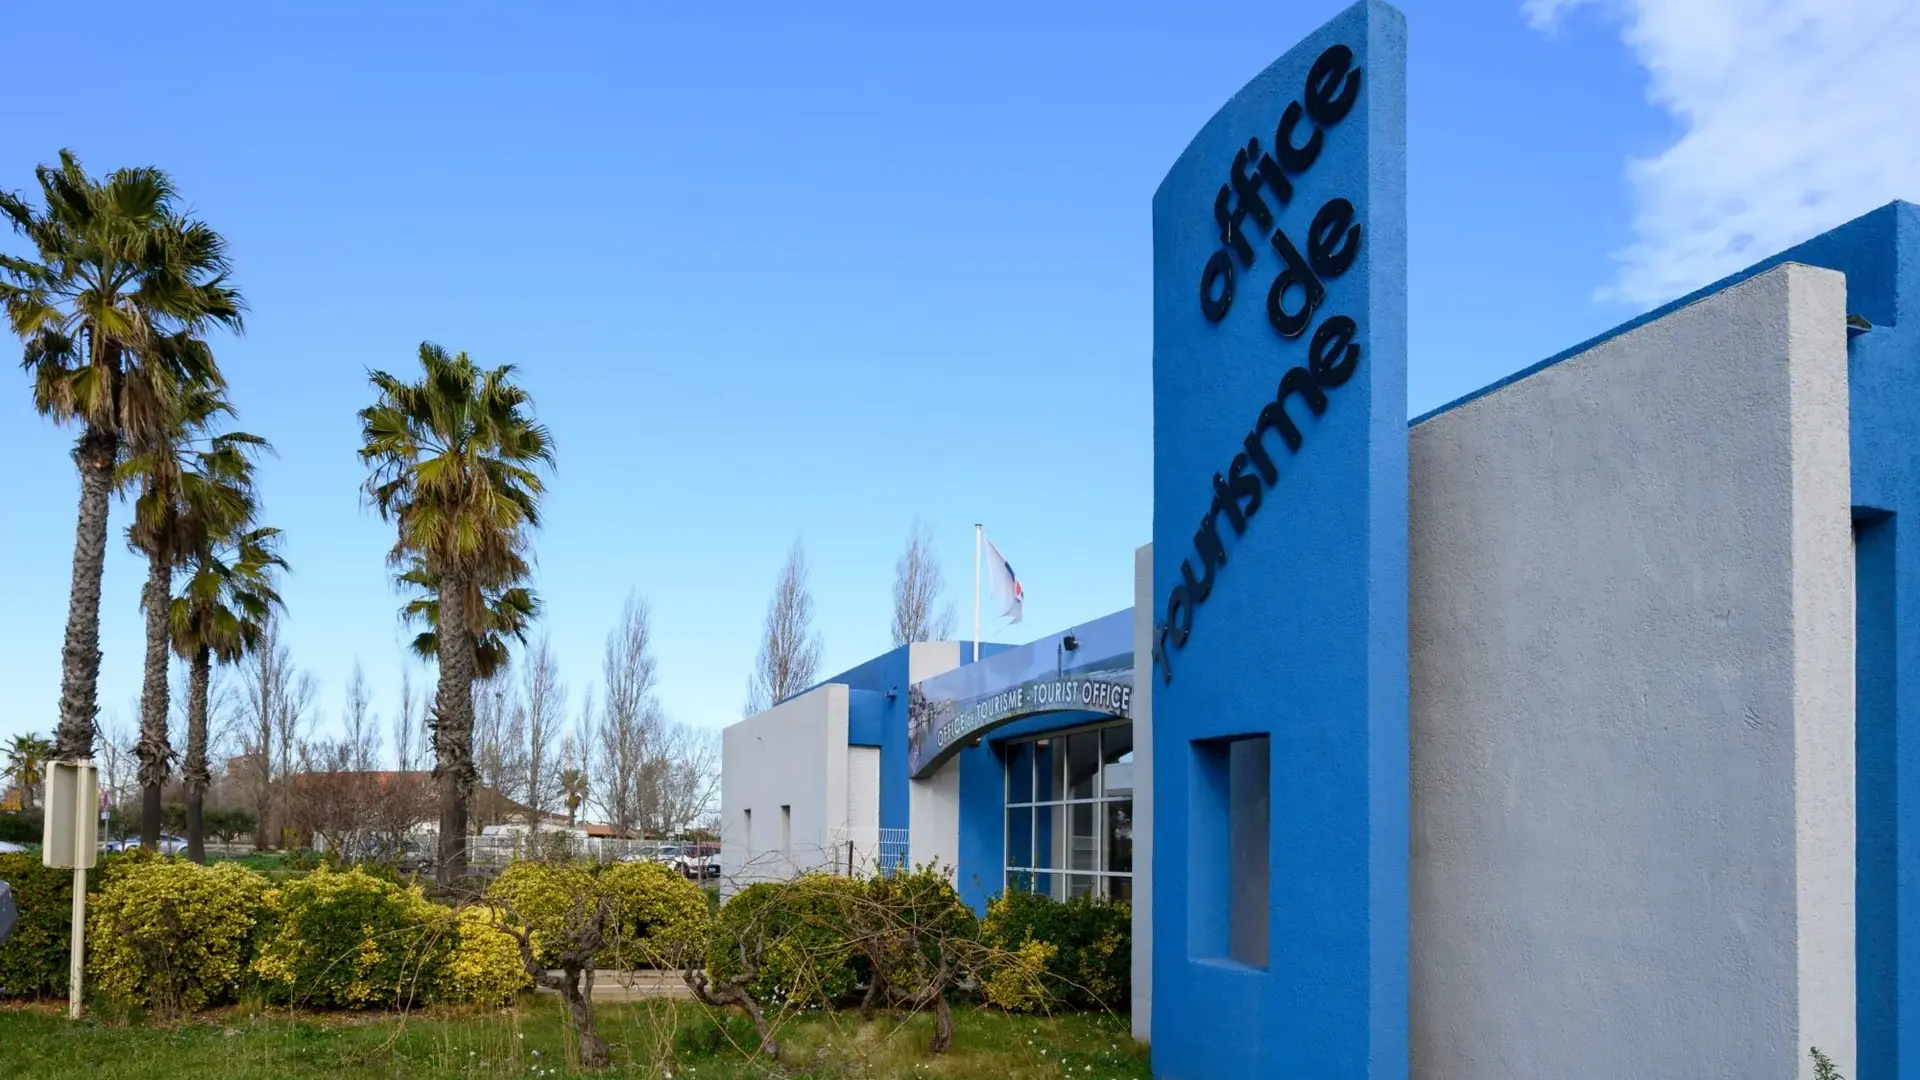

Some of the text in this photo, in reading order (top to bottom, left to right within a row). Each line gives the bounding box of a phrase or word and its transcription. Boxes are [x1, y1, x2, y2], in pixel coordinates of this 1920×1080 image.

[1200, 44, 1362, 323] office
[1267, 197, 1362, 338] de
[937, 713, 965, 747] OFFICE
[976, 688, 1023, 719] TOURISME
[1033, 681, 1078, 704] TOURIST
[1082, 681, 1130, 710] OFFICE
